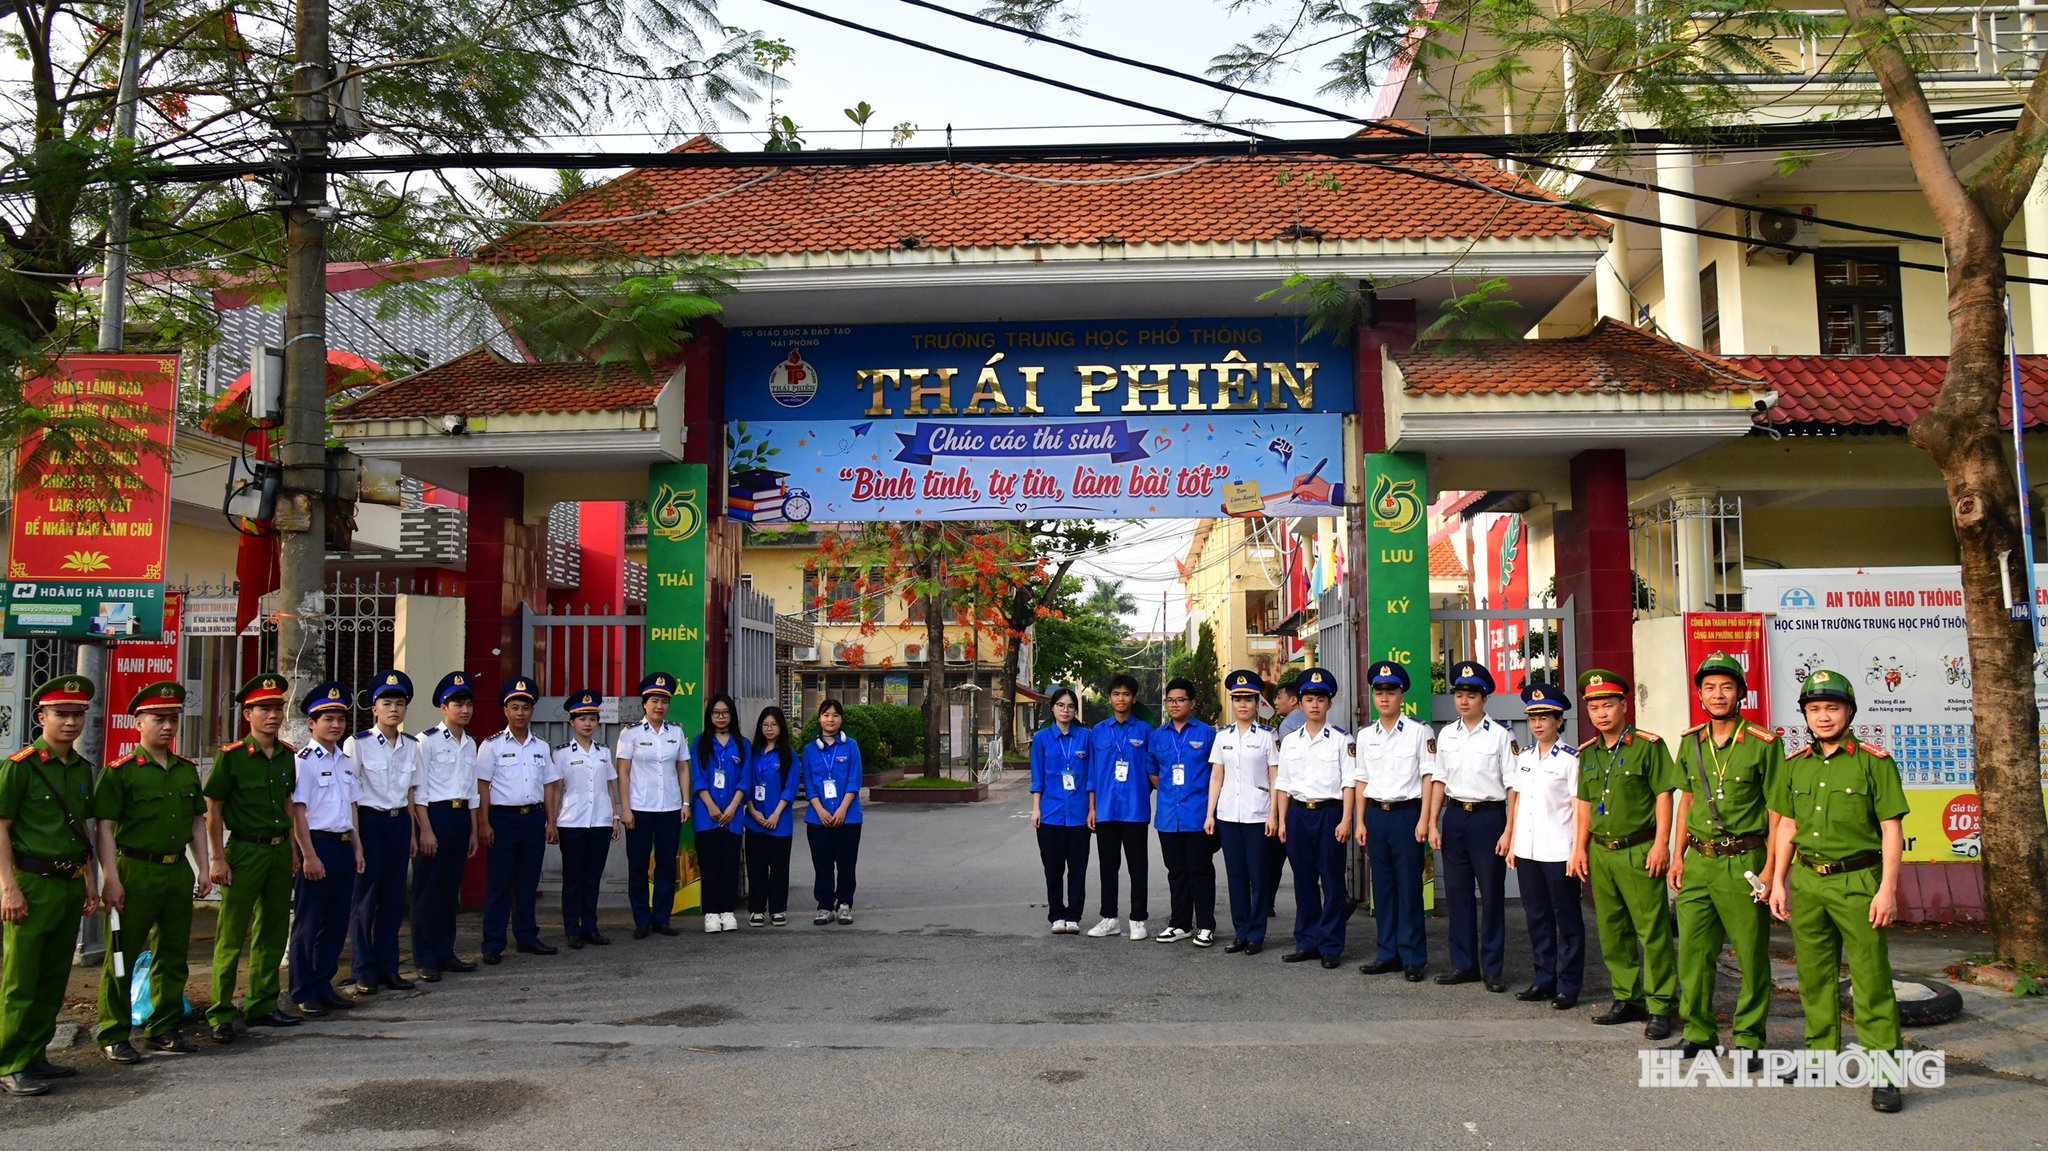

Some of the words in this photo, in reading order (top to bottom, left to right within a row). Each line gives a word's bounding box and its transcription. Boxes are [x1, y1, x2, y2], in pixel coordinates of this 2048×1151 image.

[757, 327, 780, 337] GIÁO
[783, 328, 800, 336] DỤC
[912, 333, 997, 350] TRƯỜNG
[1005, 331, 1075, 347] TRUNG
[1085, 329, 1129, 349] HỌC
[1138, 320, 1180, 345] PHỔ
[1189, 327, 1262, 344] THÔNG
[789, 336, 820, 346] PHÒNG
[86, 378, 116, 395] LÃNH
[856, 352, 1045, 417] THÁI
[1074, 349, 1320, 412] PHIÊN
[928, 427, 984, 453] Chúc
[989, 429, 1028, 451] các
[1033, 427, 1063, 451] thí
[1068, 426, 1117, 450] sinh
[922, 466, 980, 503] tĩnh,
[987, 468, 1017, 503] tự
[1022, 467, 1064, 502] tin,
[1072, 465, 1121, 498] làm
[1128, 465, 1171, 497] bài
[25, 516, 41, 535] ĐỂ
[42, 519, 74, 536] NHÂN
[103, 518, 127, 536] LÀM
[130, 517, 153, 536] CHỦ
[1381, 548, 1414, 563] LƯU
[657, 569, 694, 586] THÁI
[40, 586, 82, 597] HOÀNG
[86, 586, 104, 598] HÀ
[108, 588, 155, 598] MOBILE
[1826, 591, 1843, 607] AN
[1848, 588, 1881, 607] TOÀN
[1885, 590, 1915, 607] GIAO
[1920, 588, 1962, 606] THÔNG
[1387, 597, 1410, 614] KÝ
[2011, 604, 2029, 618] 104
[651, 624, 698, 641] PHIÊN
[1774, 619, 1794, 633] HỌC
[1796, 619, 1819, 630] SINH
[1821, 616, 1861, 630] TRƯỜNG
[1863, 617, 1896, 630] TRUNG
[1899, 617, 1918, 632] HỌC
[1920, 615, 1940, 629] PHỔ
[1388, 646, 1411, 664] ỨC
[117, 657, 145, 676] HẠNH
[147, 655, 173, 675] PHÚC
[1950, 803, 1966, 812] Giá
[1967, 803, 1979, 812] từ
